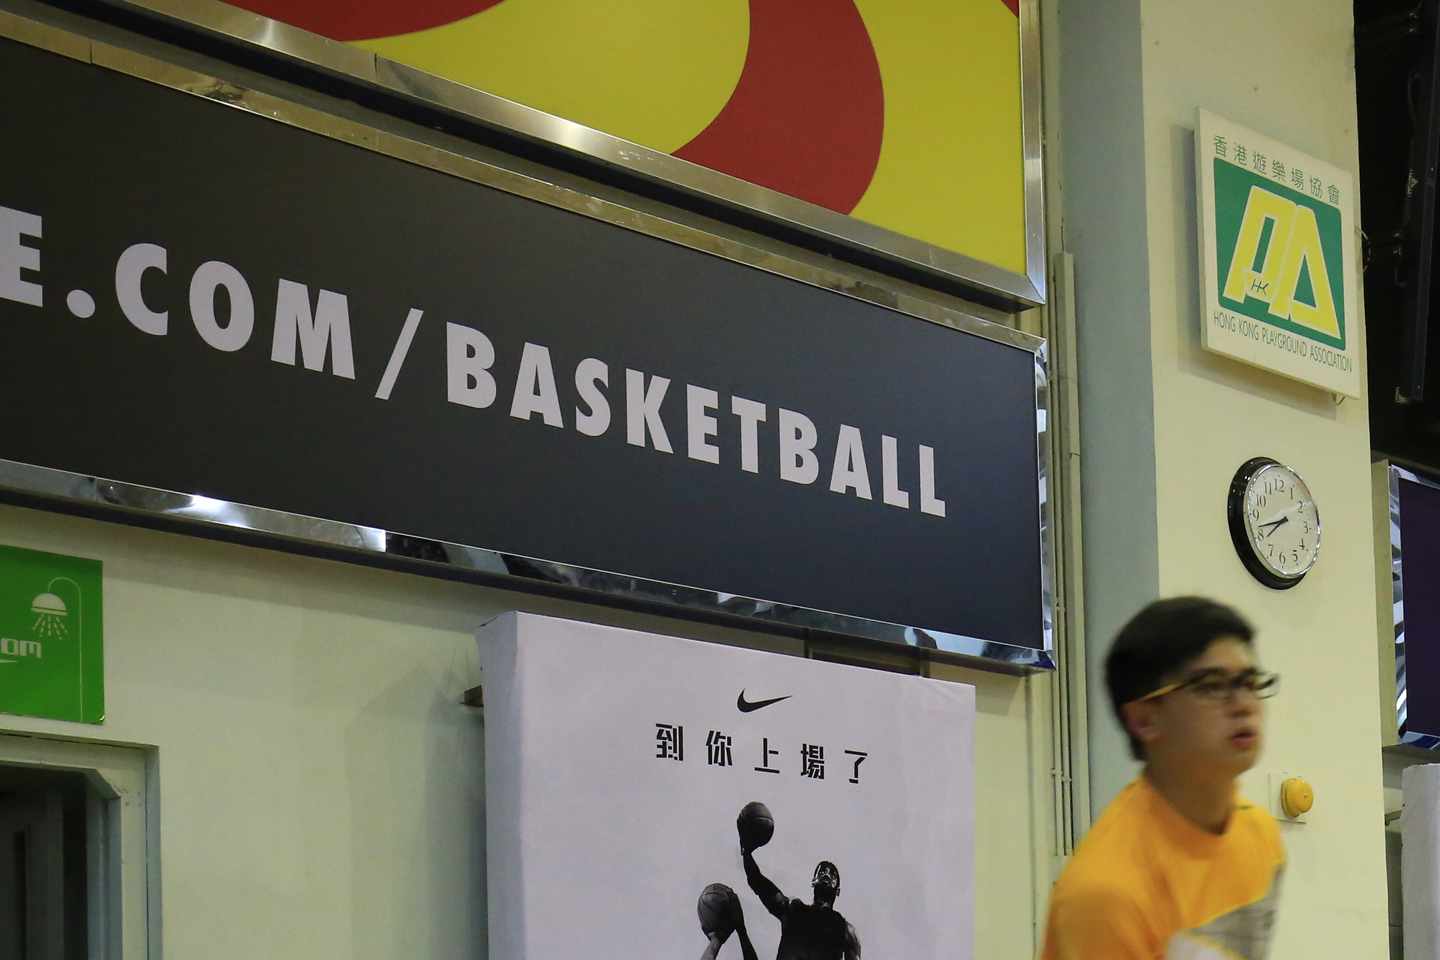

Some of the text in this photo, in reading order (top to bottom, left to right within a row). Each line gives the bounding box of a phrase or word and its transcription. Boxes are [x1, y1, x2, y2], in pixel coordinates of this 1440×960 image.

[1213, 135, 1340, 205] 香港遊樂場協會
[1213, 310, 1353, 373] HONG KONG PLAYGROUND ASSOCIATION
[1263, 481, 1272, 495] 11
[1274, 478, 1285, 493] 12
[1255, 493, 1267, 507] 10
[1289, 487, 1294, 500] 1
[1297, 500, 1303, 514] 2
[1252, 508, 1260, 521] 9
[1303, 521, 1309, 534] 3
[1257, 528, 1265, 542] 8
[1268, 543, 1275, 557] 7
[1298, 538, 1305, 551] 4
[1279, 551, 1286, 565] 6
[1292, 549, 1299, 562] 5
[655, 723, 868, 785] 到你上場了
